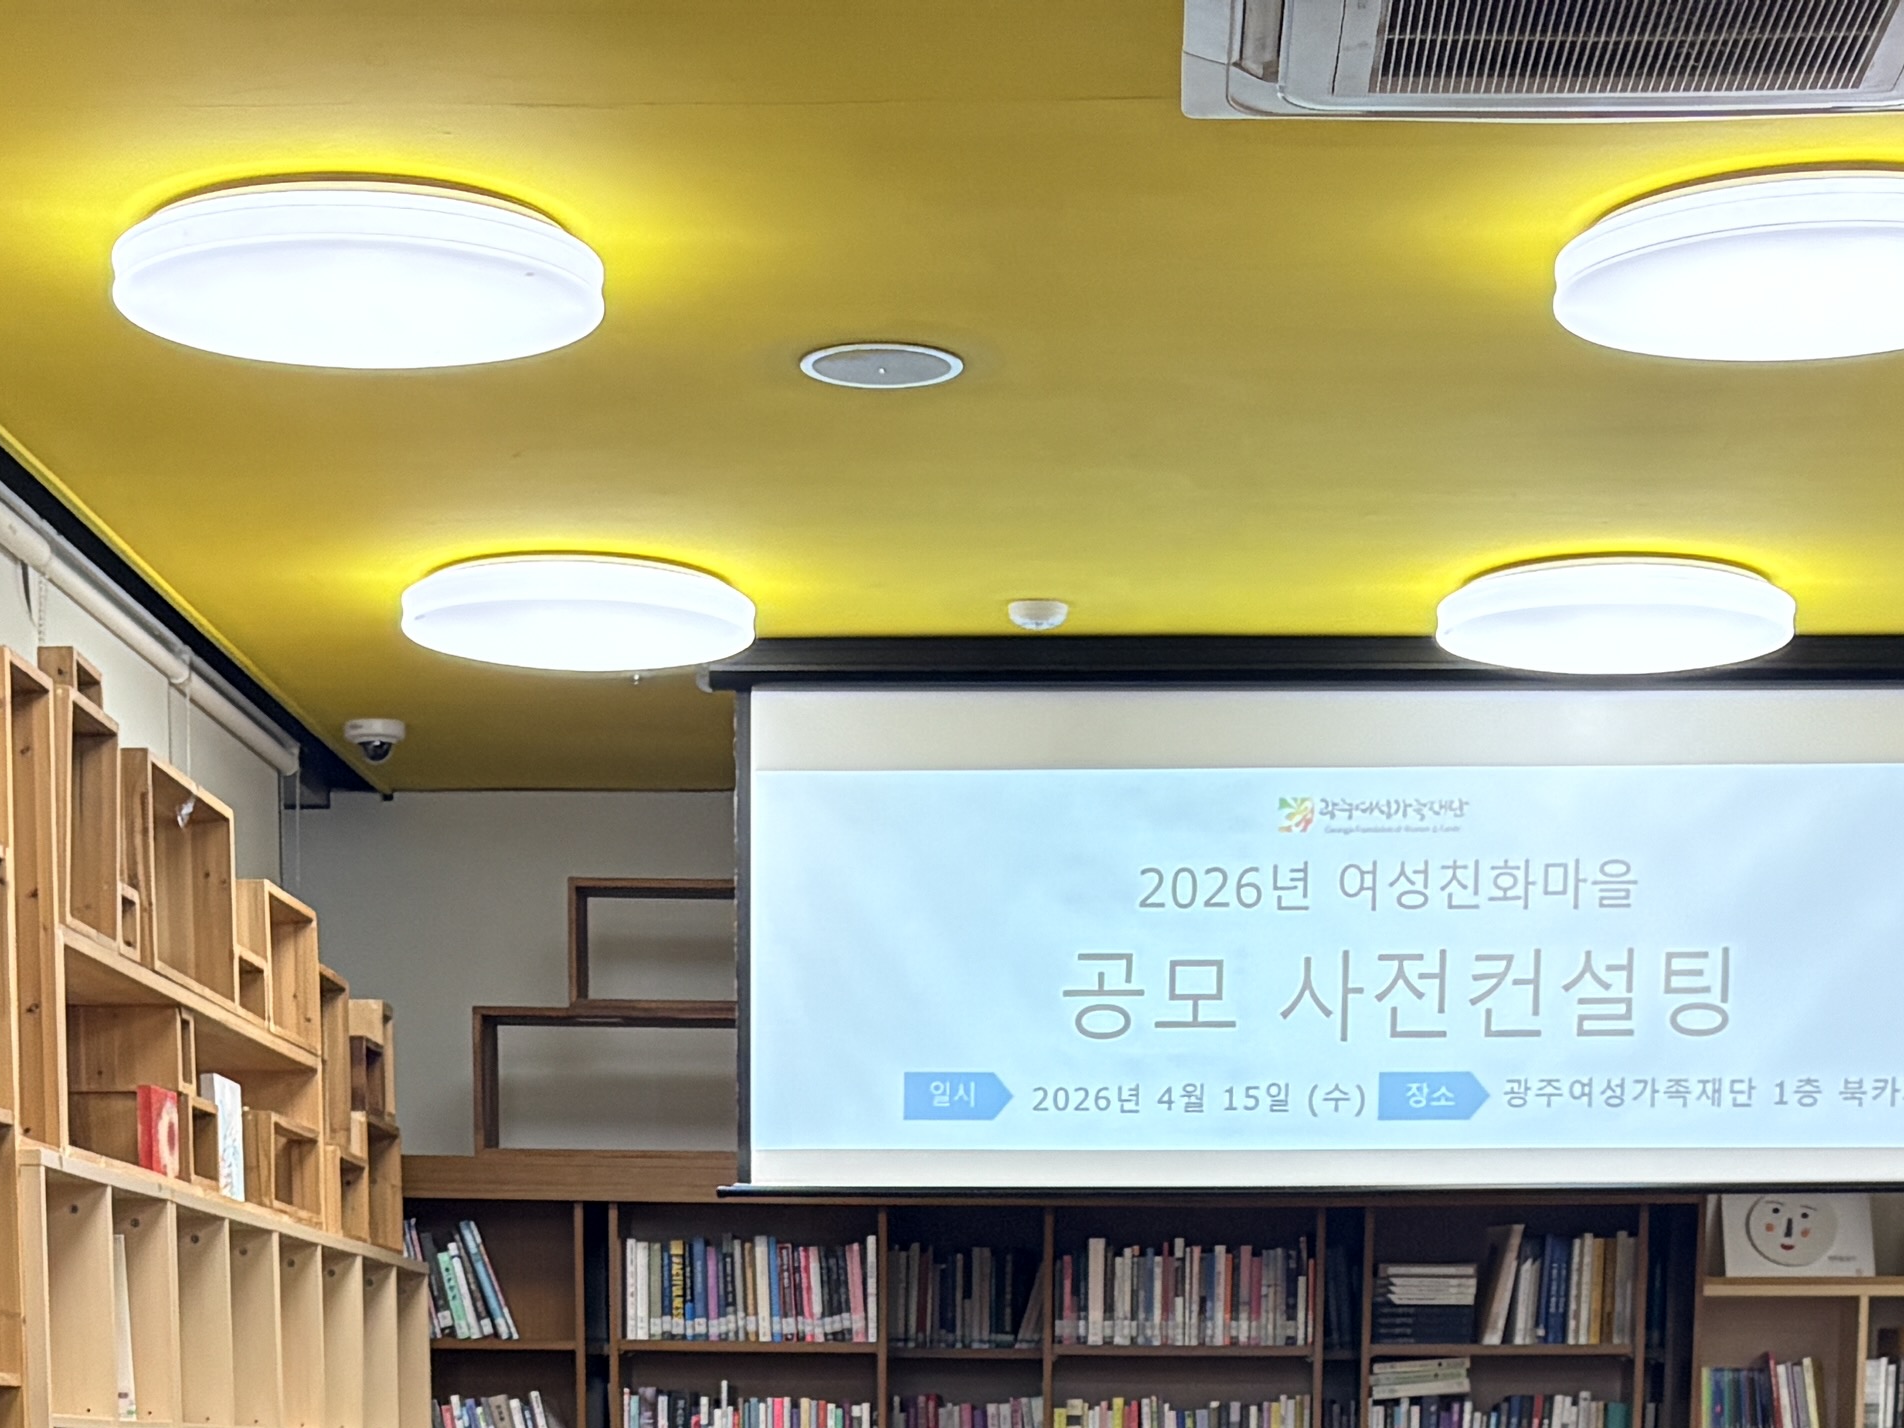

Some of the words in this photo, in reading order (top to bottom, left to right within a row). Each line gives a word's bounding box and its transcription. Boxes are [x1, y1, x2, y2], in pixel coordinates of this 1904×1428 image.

[1137, 858, 1311, 912] 2026년
[1338, 857, 1639, 912] 여성친화마을
[1061, 950, 1238, 1041] 공모
[1278, 944, 1734, 1043] 사전컨설팅
[930, 1081, 977, 1108] 일시
[1032, 1084, 1141, 1113] 2026년
[1157, 1083, 1206, 1114] 4월
[1223, 1082, 1290, 1113] 15일
[1308, 1081, 1366, 1116] (수)
[1404, 1081, 1456, 1109] 장소
[1503, 1076, 1757, 1109] 광주여성가족재단
[1774, 1077, 1823, 1109] 1층
